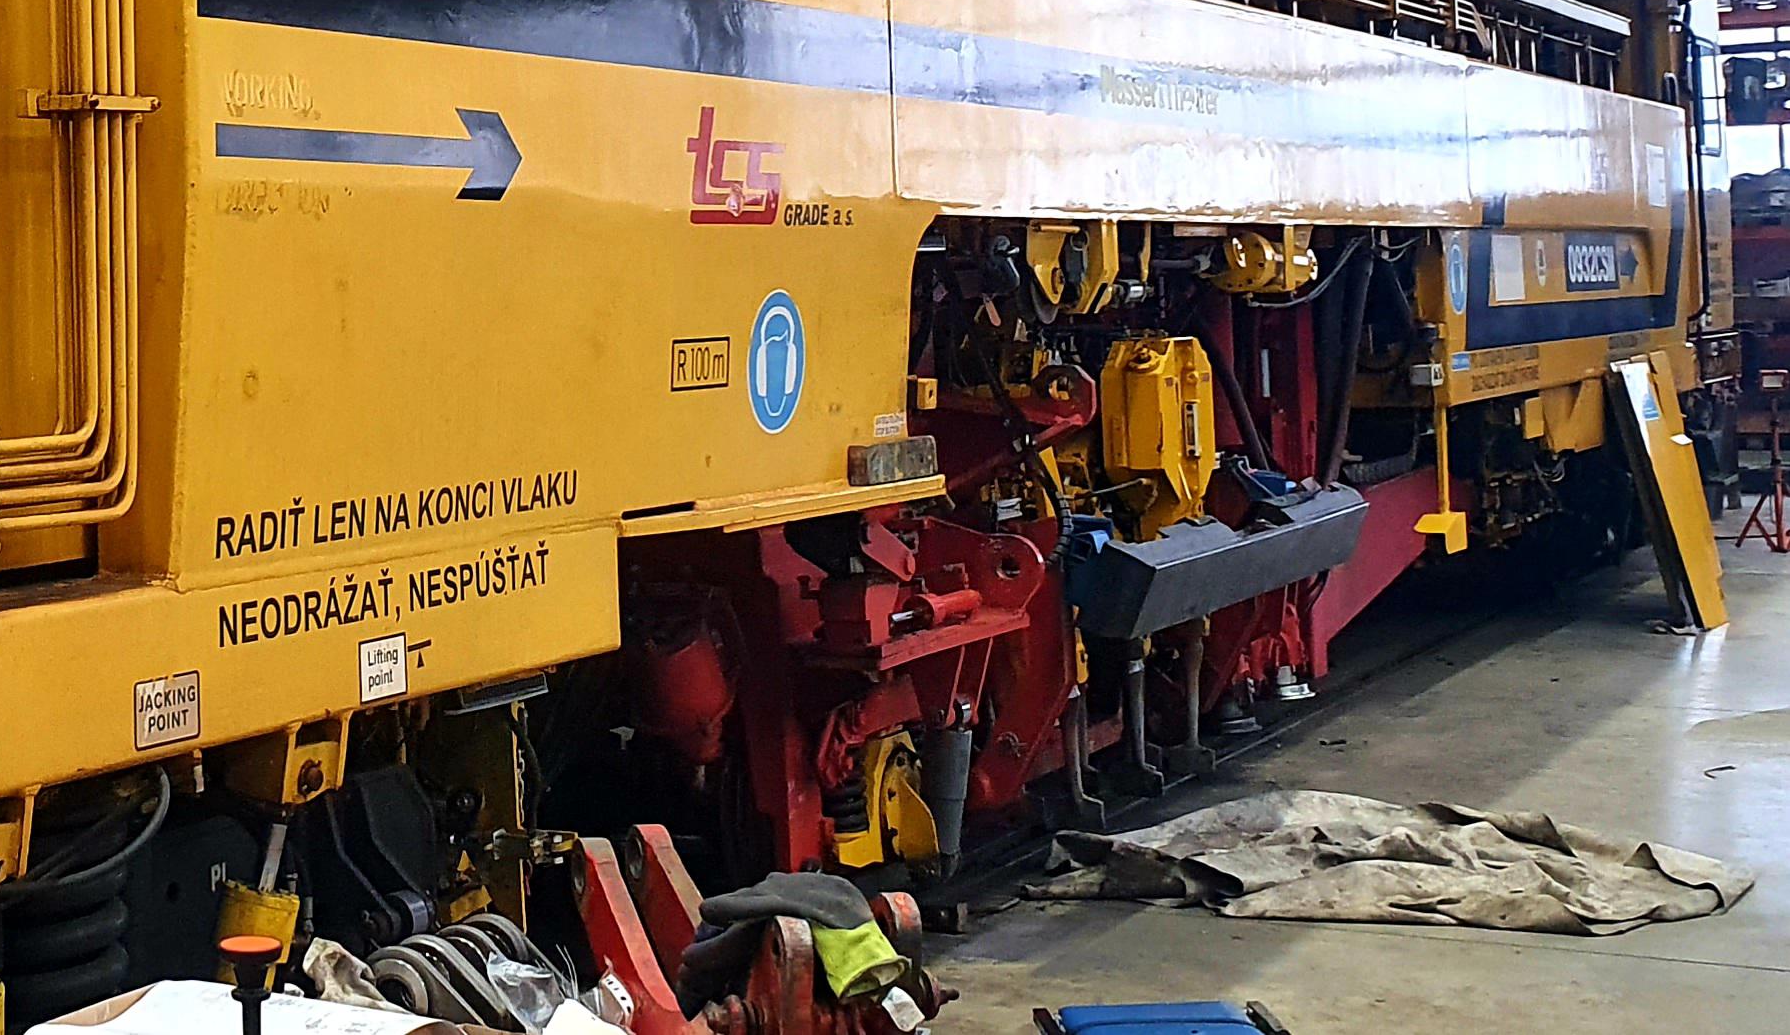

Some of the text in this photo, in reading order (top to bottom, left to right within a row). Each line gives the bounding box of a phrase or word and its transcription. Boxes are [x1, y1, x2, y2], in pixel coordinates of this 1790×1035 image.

[784, 204, 829, 226] GRADE
[677, 349, 687, 381] R
[691, 347, 710, 381] 100
[215, 469, 578, 559] RADIŤ LEN NA KONCI VLAKU
[219, 540, 550, 648] NEODRÁŽAŤ, NESPÚŠŤAŤ
[367, 647, 399, 667] Lifting
[368, 669, 394, 692] point
[139, 684, 196, 713] JACKING
[148, 709, 189, 733] POINT
